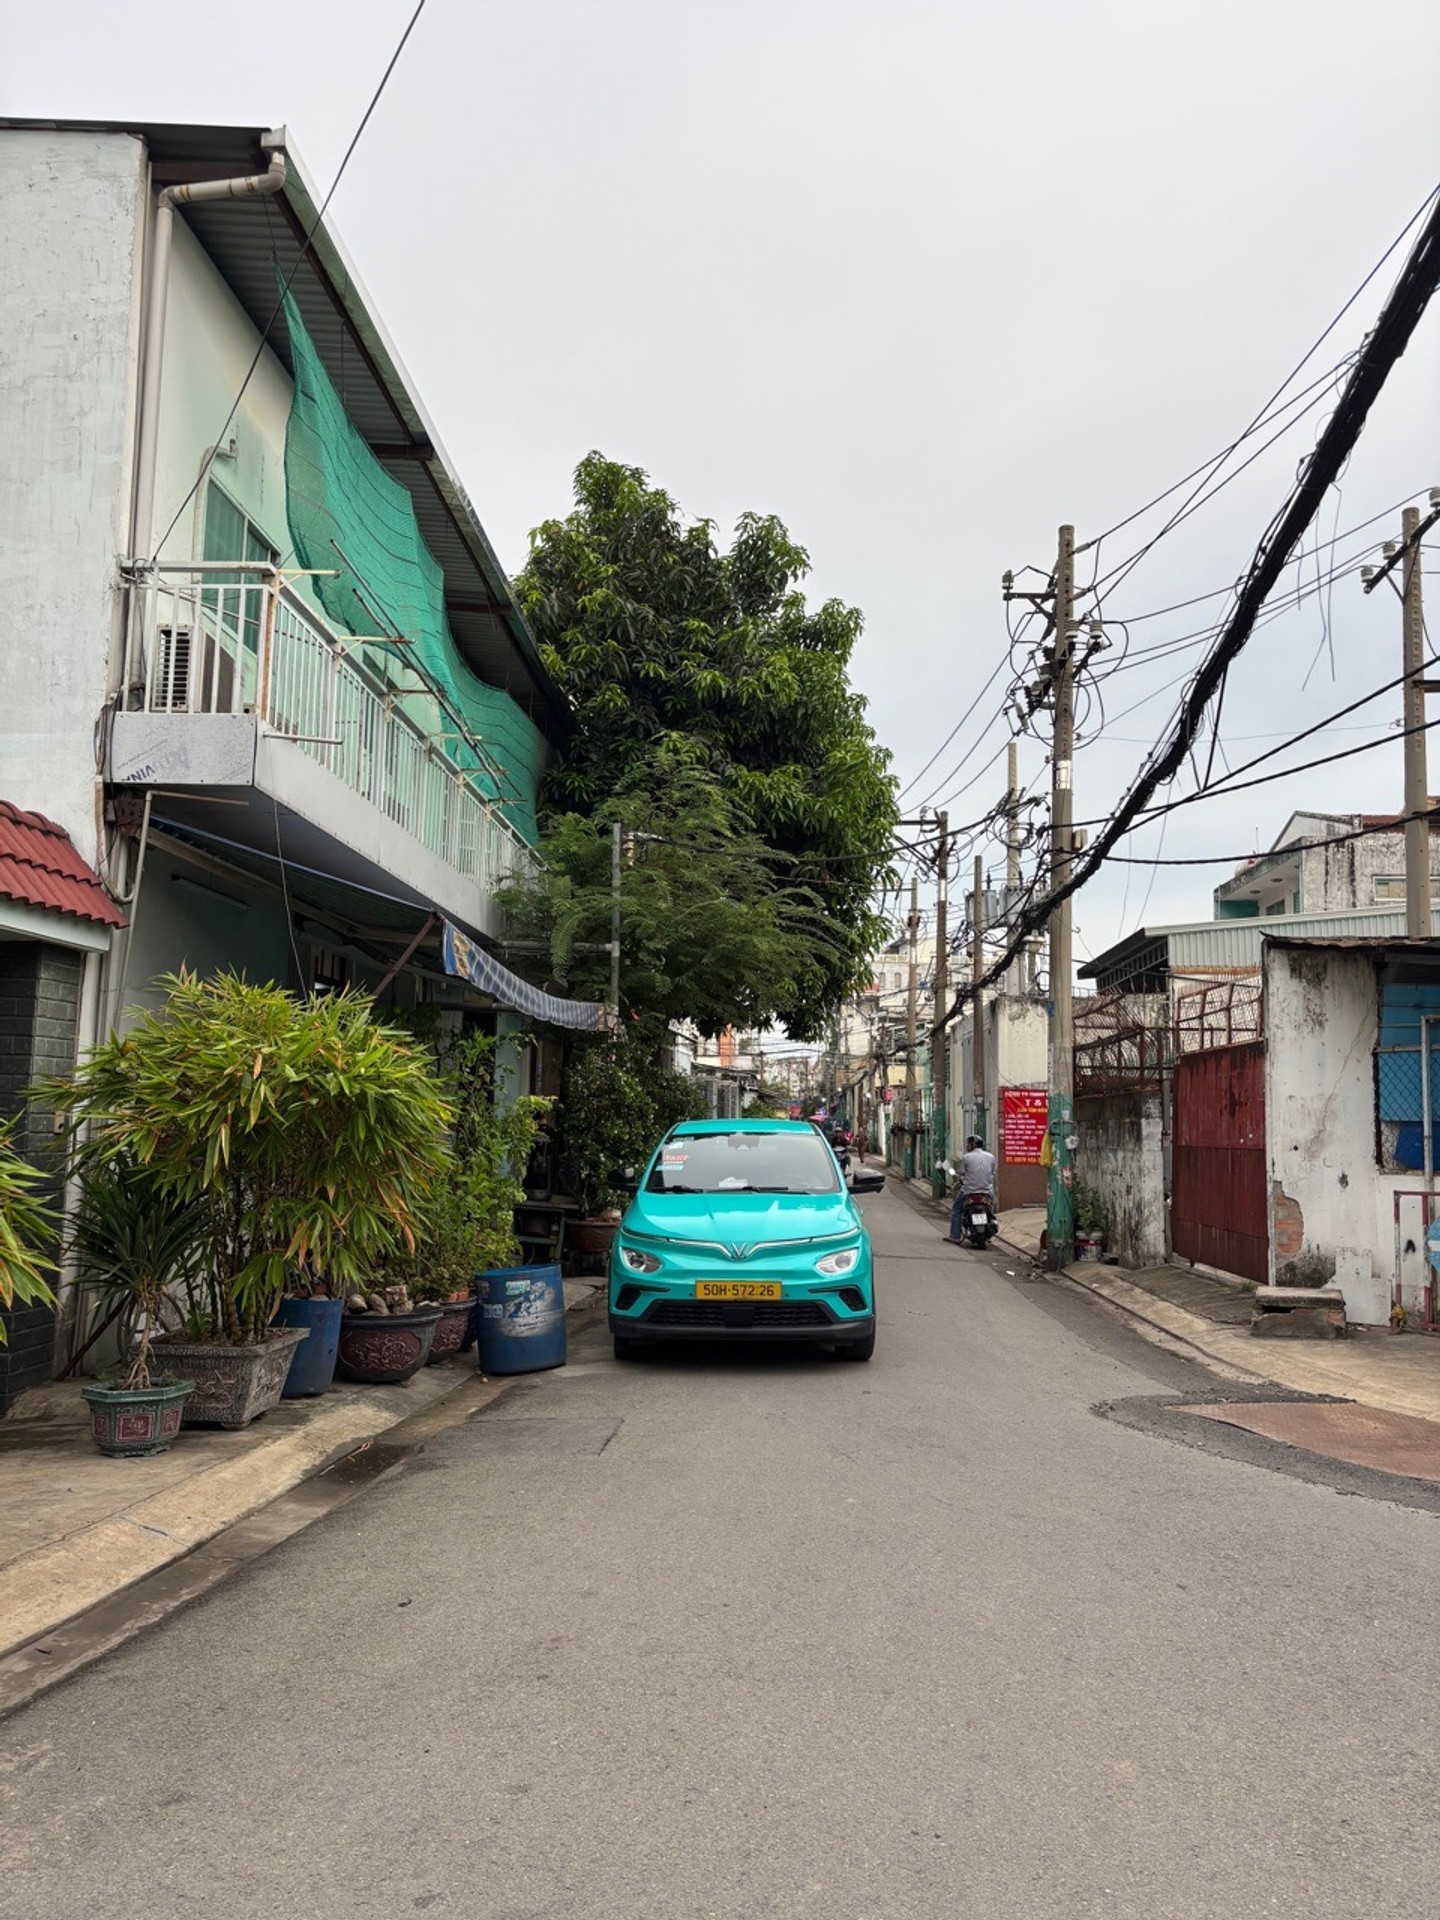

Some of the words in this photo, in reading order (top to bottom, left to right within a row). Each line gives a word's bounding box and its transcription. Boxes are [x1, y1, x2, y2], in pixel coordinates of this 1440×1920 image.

[1025, 1099, 1031, 1107] T
[1034, 1099, 1042, 1107] &
[703, 1283, 775, 1296] 50H-572.26
